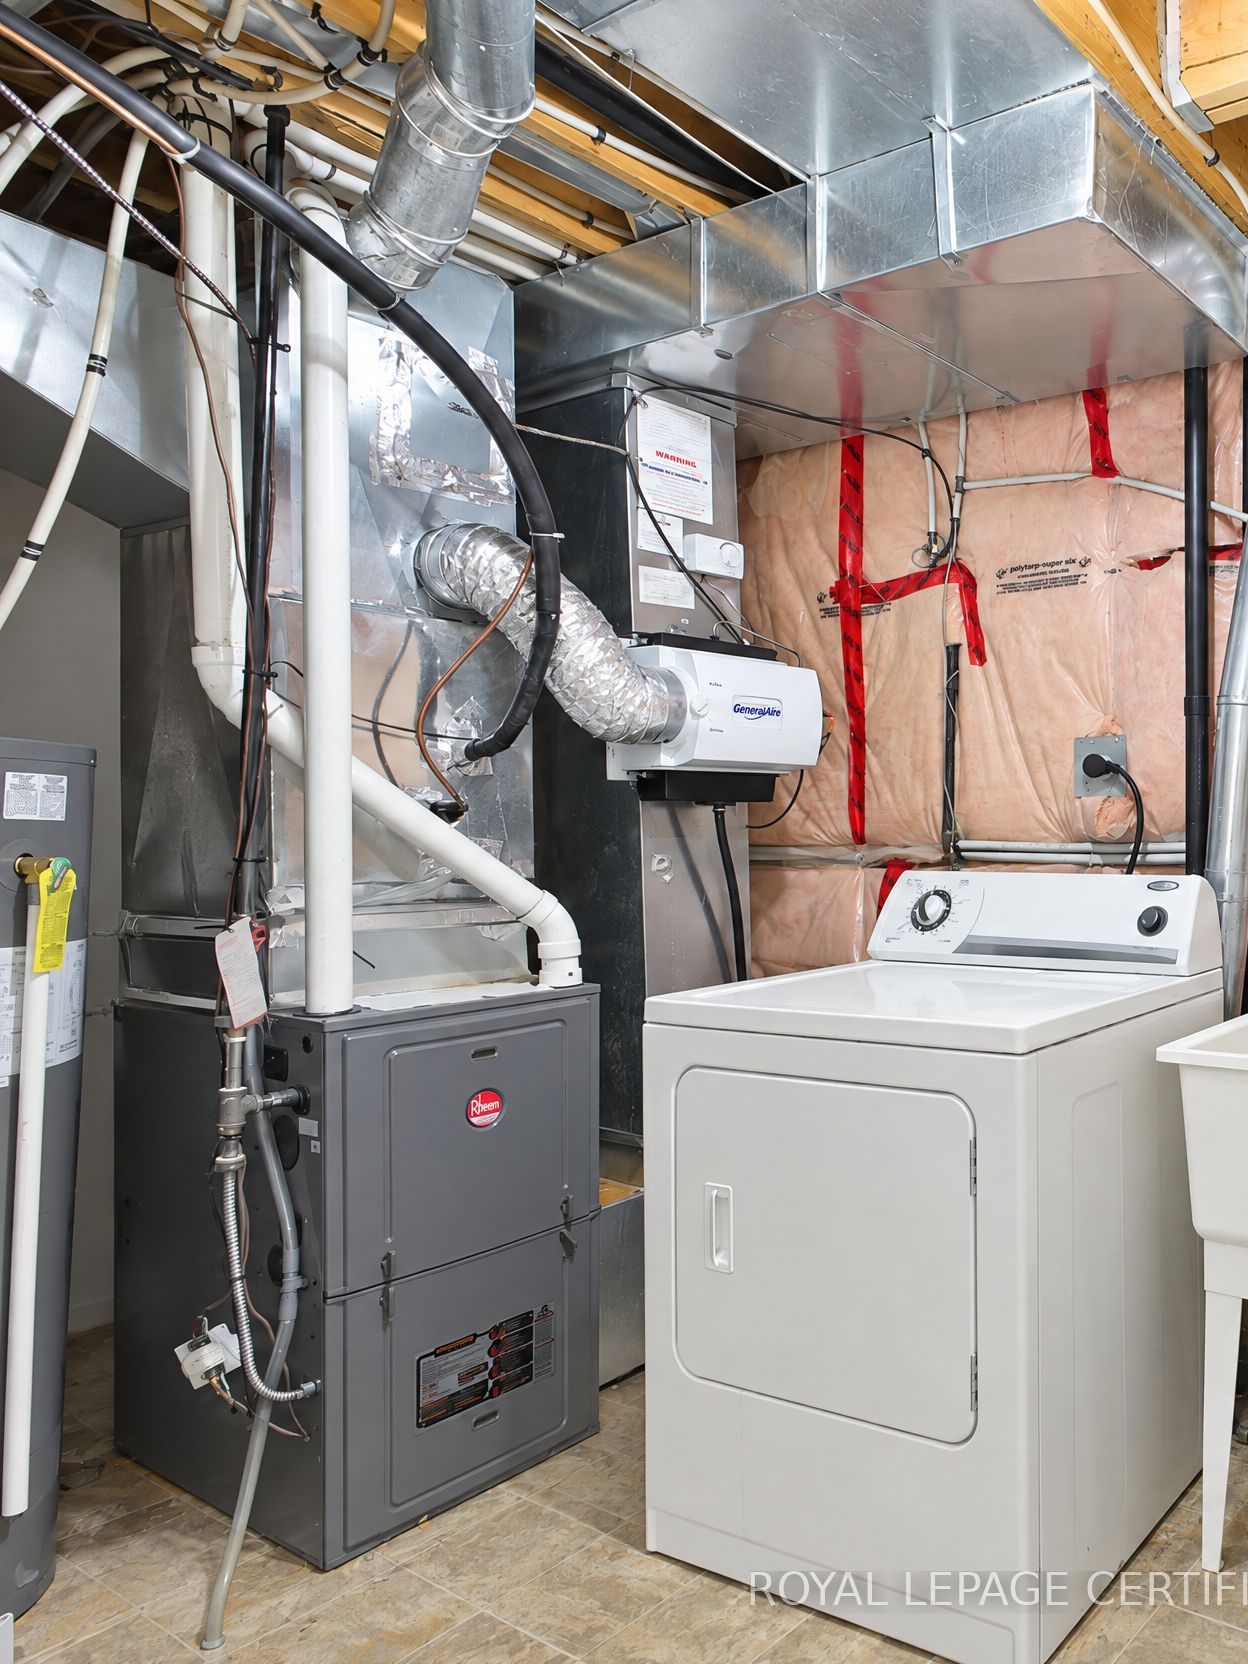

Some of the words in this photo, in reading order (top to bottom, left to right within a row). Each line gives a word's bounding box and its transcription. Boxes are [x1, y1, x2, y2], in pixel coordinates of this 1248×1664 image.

[656, 450, 697, 468] WARNING
[733, 703, 781, 718] GeneralAire
[470, 1094, 500, 1117] Rheem
